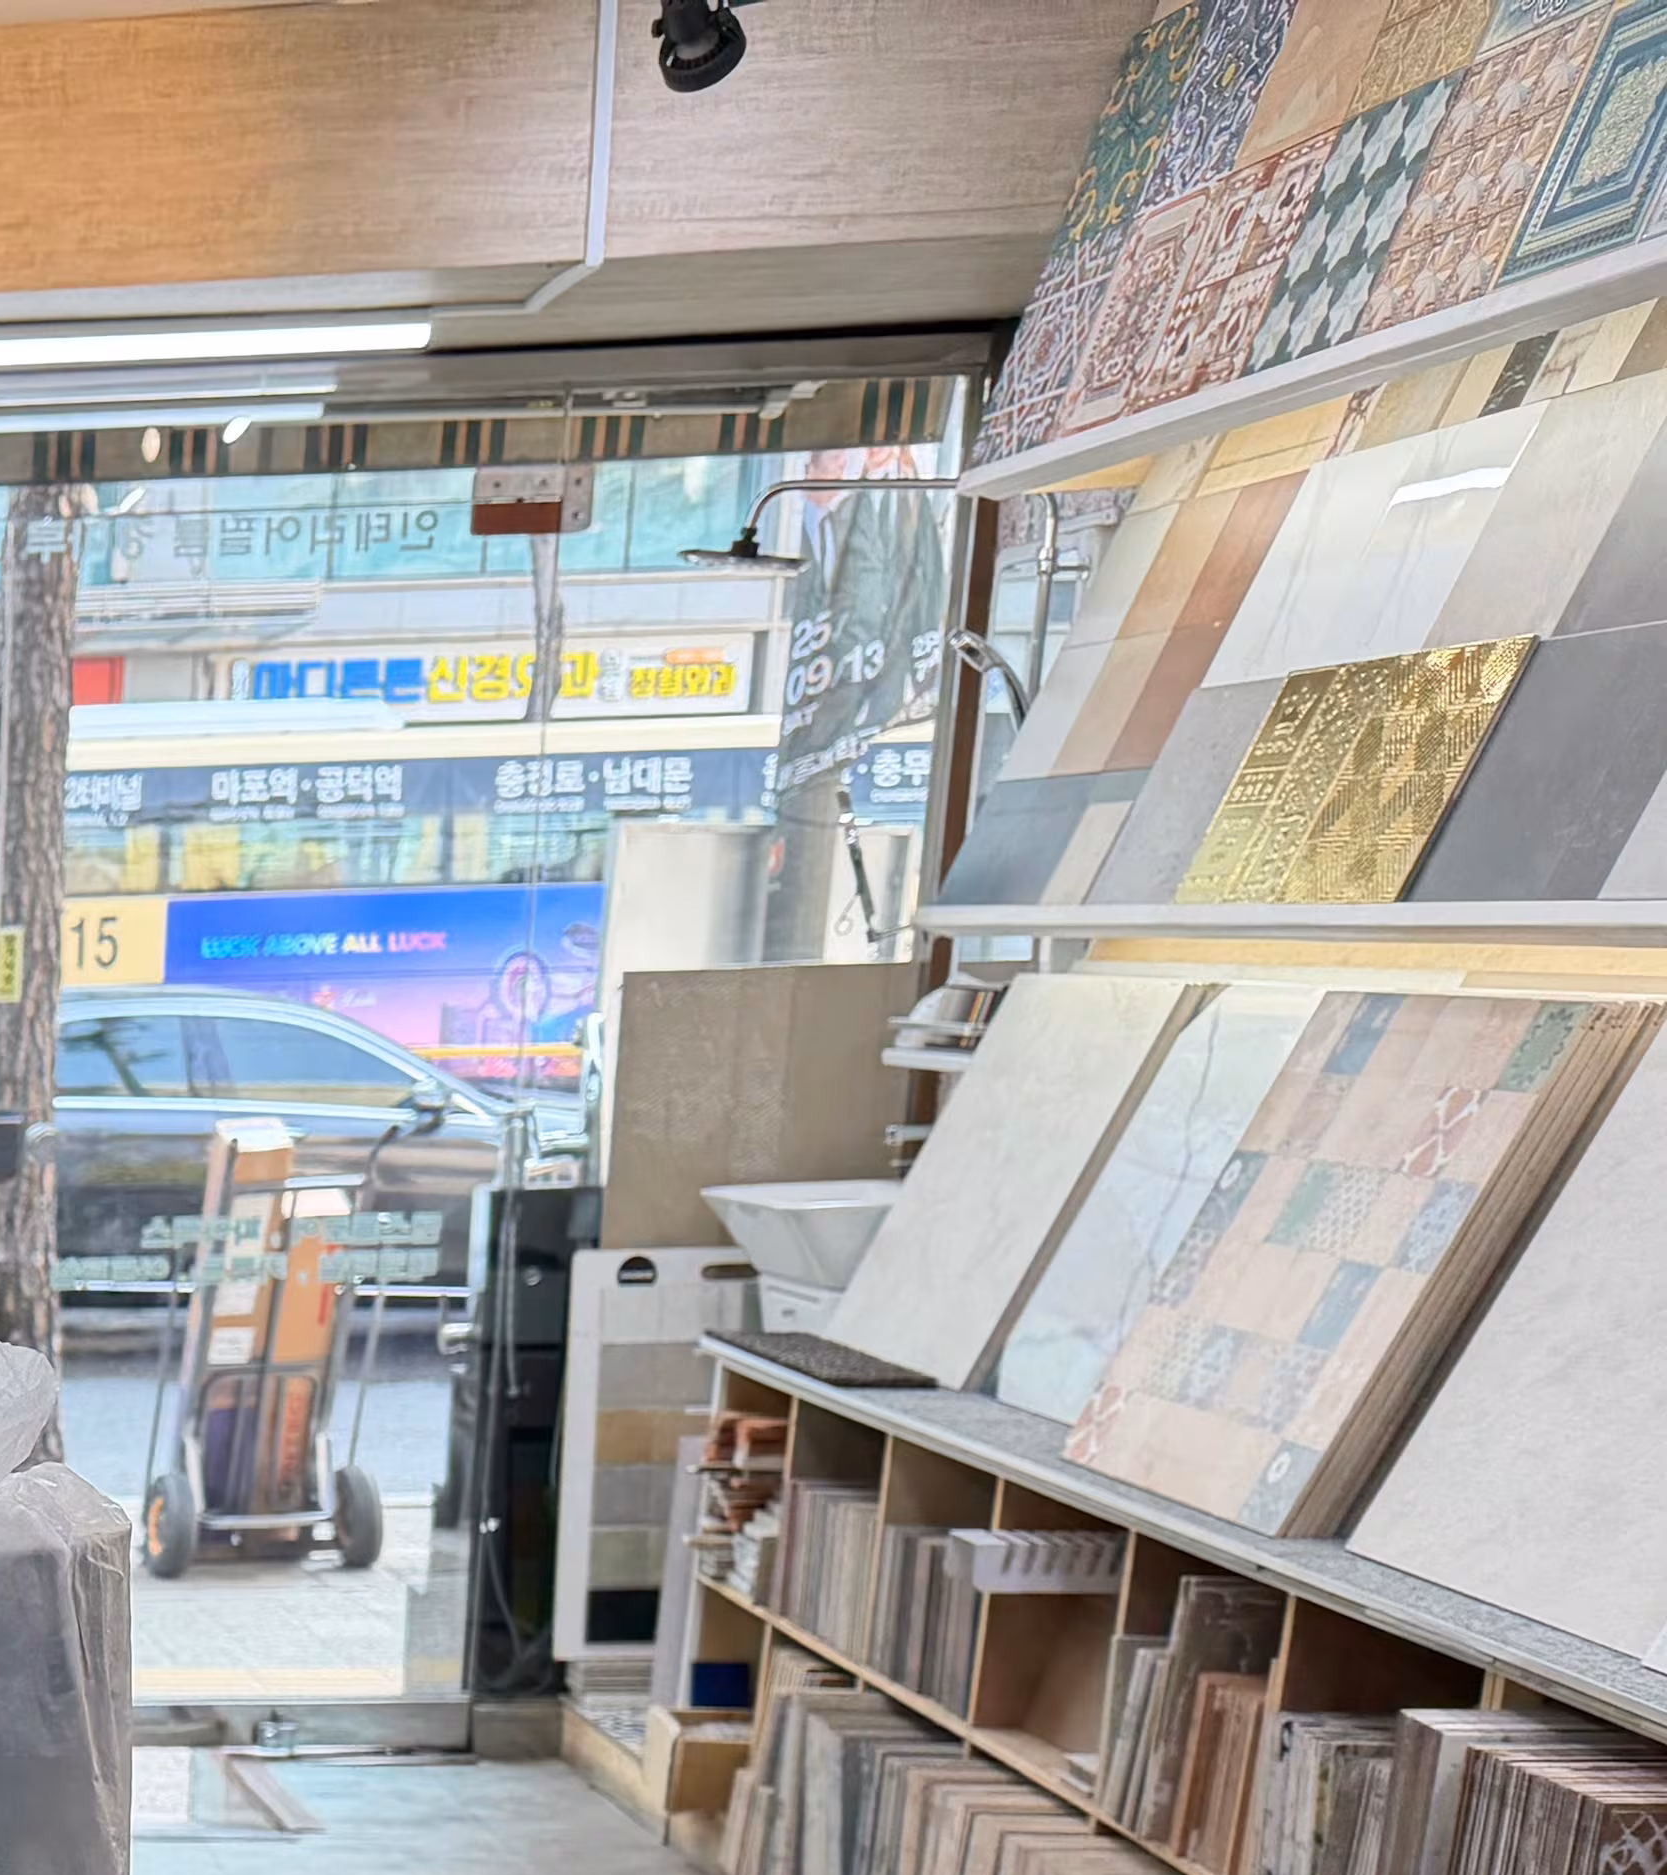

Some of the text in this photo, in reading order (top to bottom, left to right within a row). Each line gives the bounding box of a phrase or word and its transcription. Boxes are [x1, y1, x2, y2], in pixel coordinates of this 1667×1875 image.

[785, 639, 885, 706] 09/13
[265, 933, 337, 958] ABOVE
[342, 932, 381, 954] ALL
[387, 931, 447, 952] LUCK
